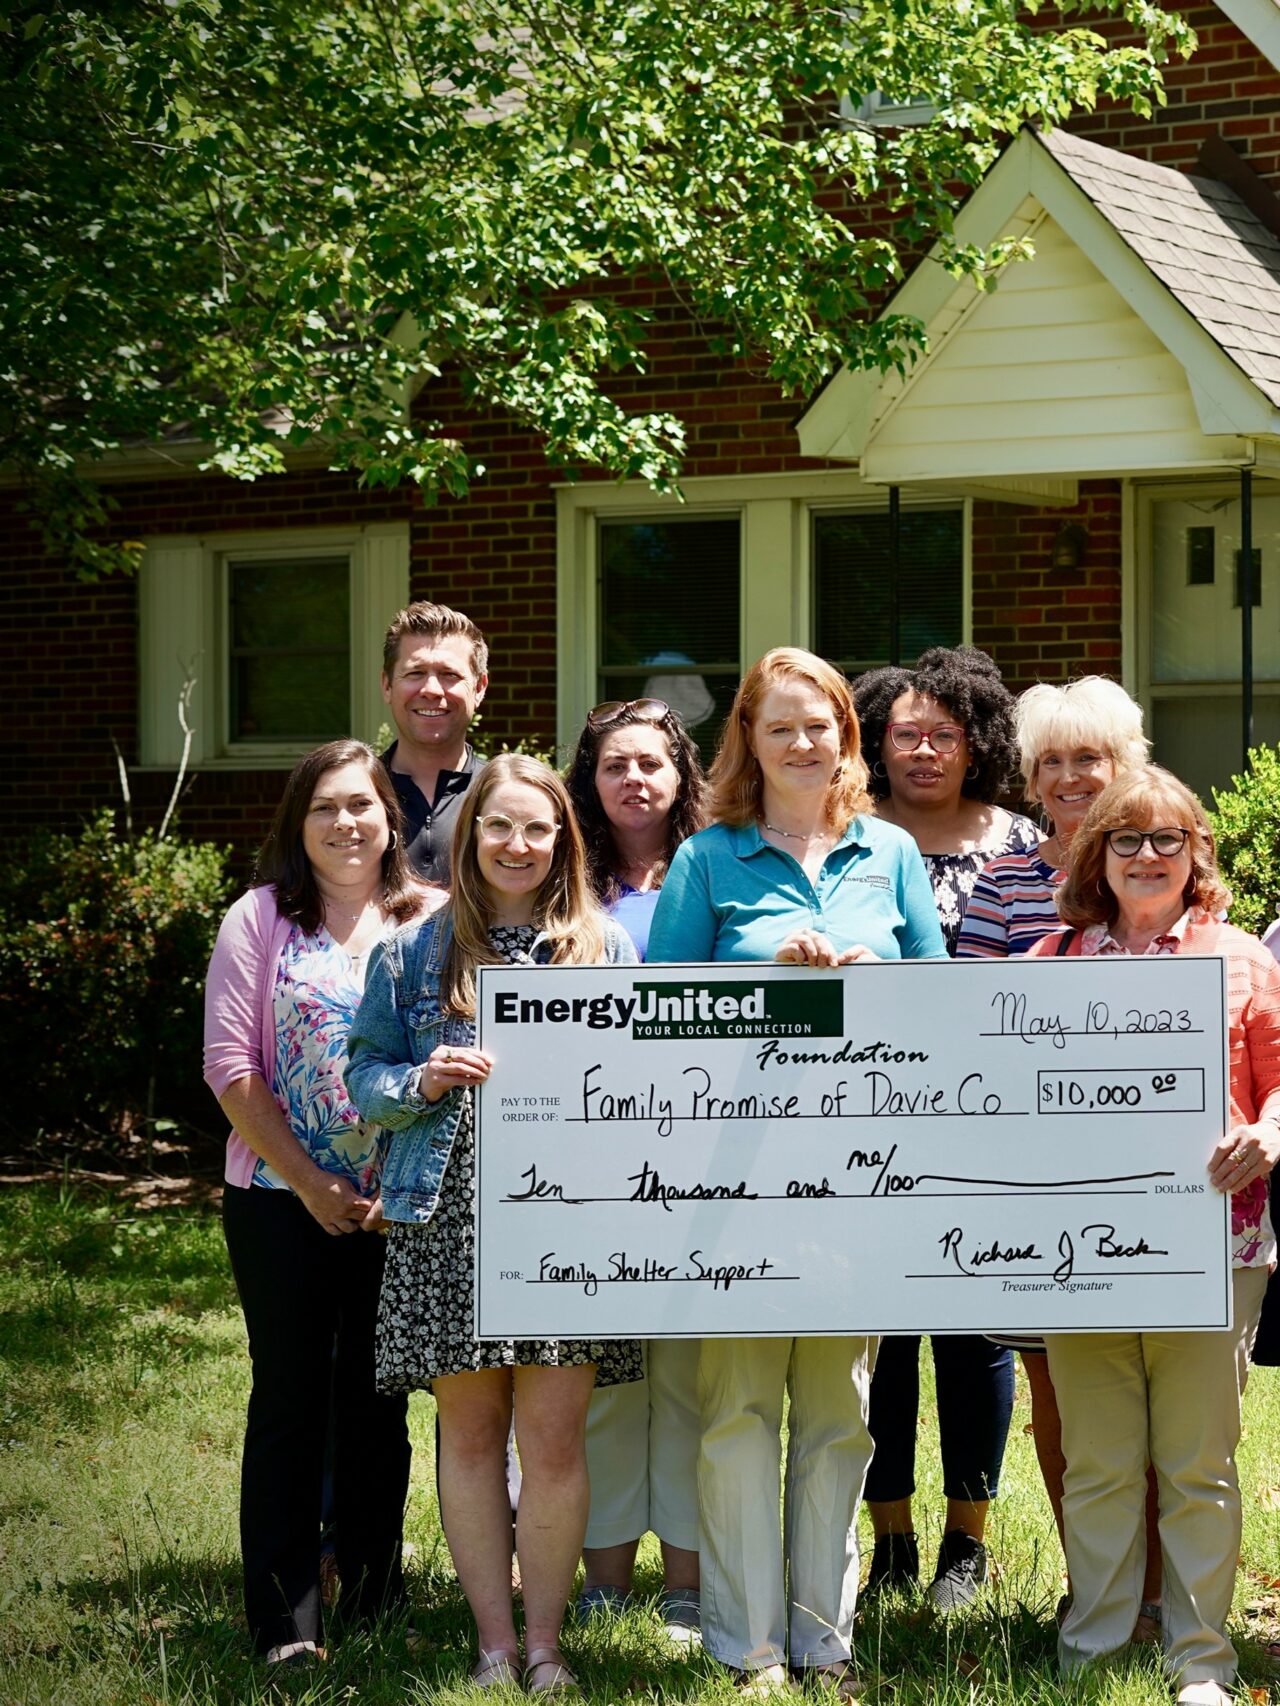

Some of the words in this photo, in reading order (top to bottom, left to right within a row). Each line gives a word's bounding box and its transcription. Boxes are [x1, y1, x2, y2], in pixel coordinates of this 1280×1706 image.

[636, 1025, 672, 1036] YOUR
[679, 1024, 720, 1035] LOCAL
[727, 1023, 812, 1035] CONNECTION
[991, 992, 1071, 1049] May
[756, 1040, 929, 1070] Foundation
[501, 1097, 520, 1107] PAY
[522, 1097, 537, 1106] TO
[540, 1097, 560, 1106] THE
[583, 1064, 673, 1137] Family
[683, 1067, 801, 1121] Promise
[820, 1081, 848, 1117] of
[864, 1071, 948, 1117] Davie
[958, 1073, 1002, 1115] Co
[502, 1113, 539, 1122] ORDER
[541, 1112, 559, 1122] OF:
[506, 1163, 583, 1204] Ten
[786, 1177, 836, 1198] and
[1154, 1184, 1205, 1194] DOLLARS
[938, 1227, 1043, 1276] Richard
[1053, 1230, 1074, 1283] J
[500, 1271, 524, 1281] FOR:
[540, 1252, 598, 1296] Family
[608, 1252, 678, 1283] Shelter
[685, 1250, 774, 1291] Support
[1001, 1280, 1057, 1292] Treasurer
[1058, 1280, 1113, 1294] Signature
